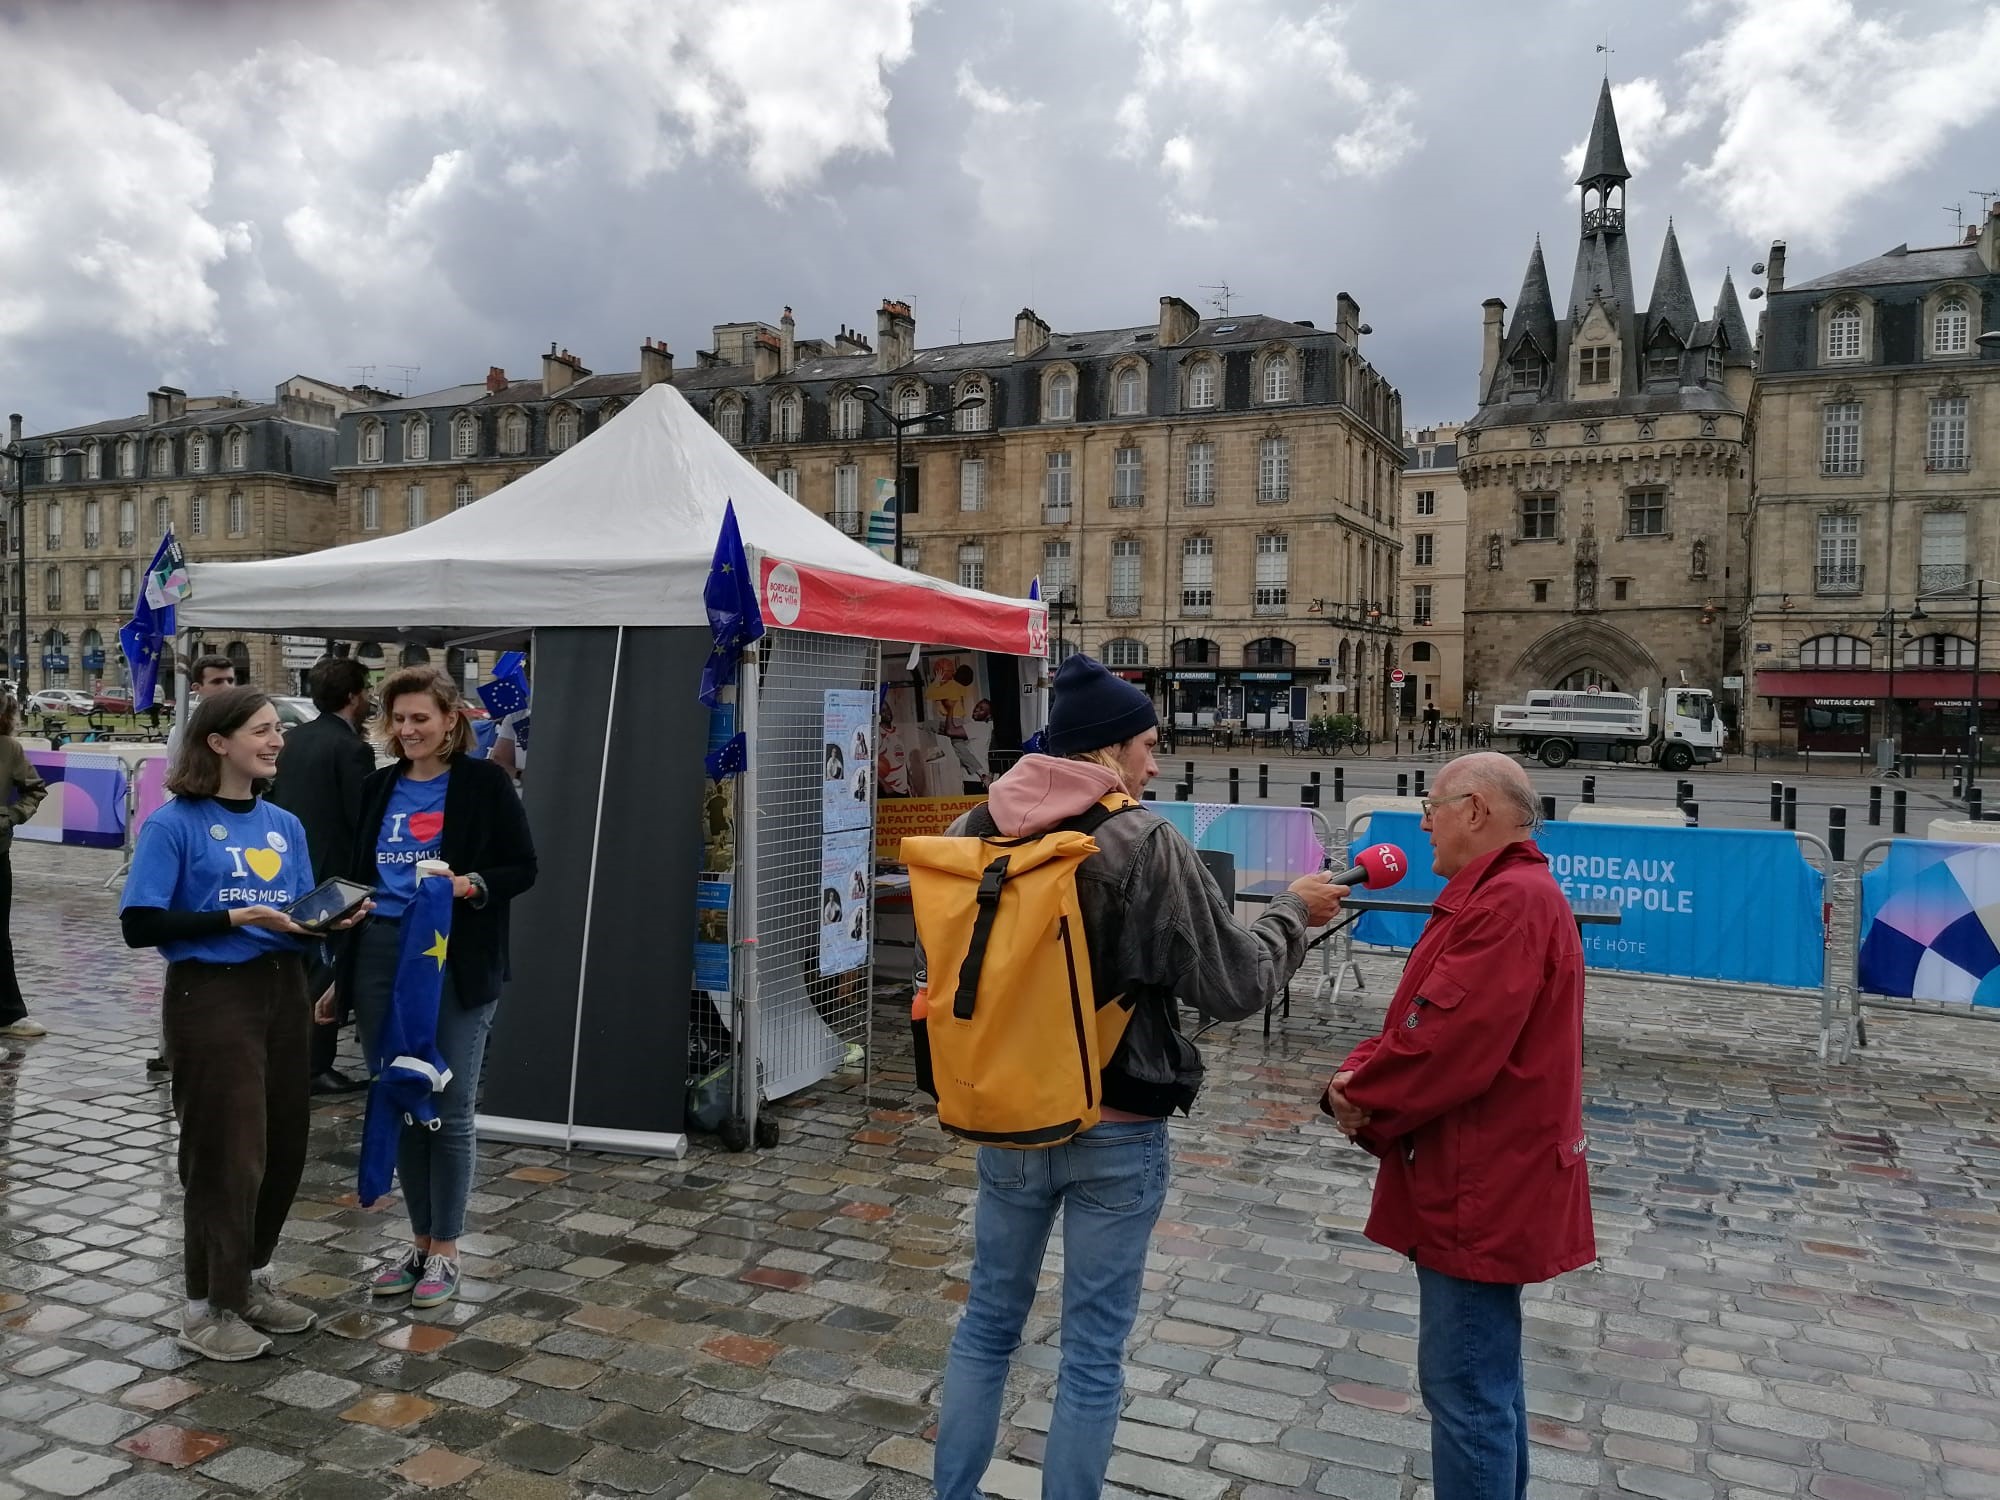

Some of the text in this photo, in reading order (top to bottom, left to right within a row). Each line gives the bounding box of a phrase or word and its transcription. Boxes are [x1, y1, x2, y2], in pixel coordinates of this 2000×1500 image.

[770, 582, 798, 594] BORDEAUX
[771, 592, 798, 606] Ma ville
[881, 803, 938, 814] IRLANDE,
[388, 813, 407, 842] I
[888, 816, 914, 824] FAIT
[876, 824, 941, 836] ENCONTRÉ
[225, 846, 248, 878] I
[1378, 845, 1399, 872] RCF
[1544, 853, 1676, 884] BORDEAUX
[1560, 876, 1694, 914] ÉTROPOLE
[1606, 938, 1648, 954] HÔTE
